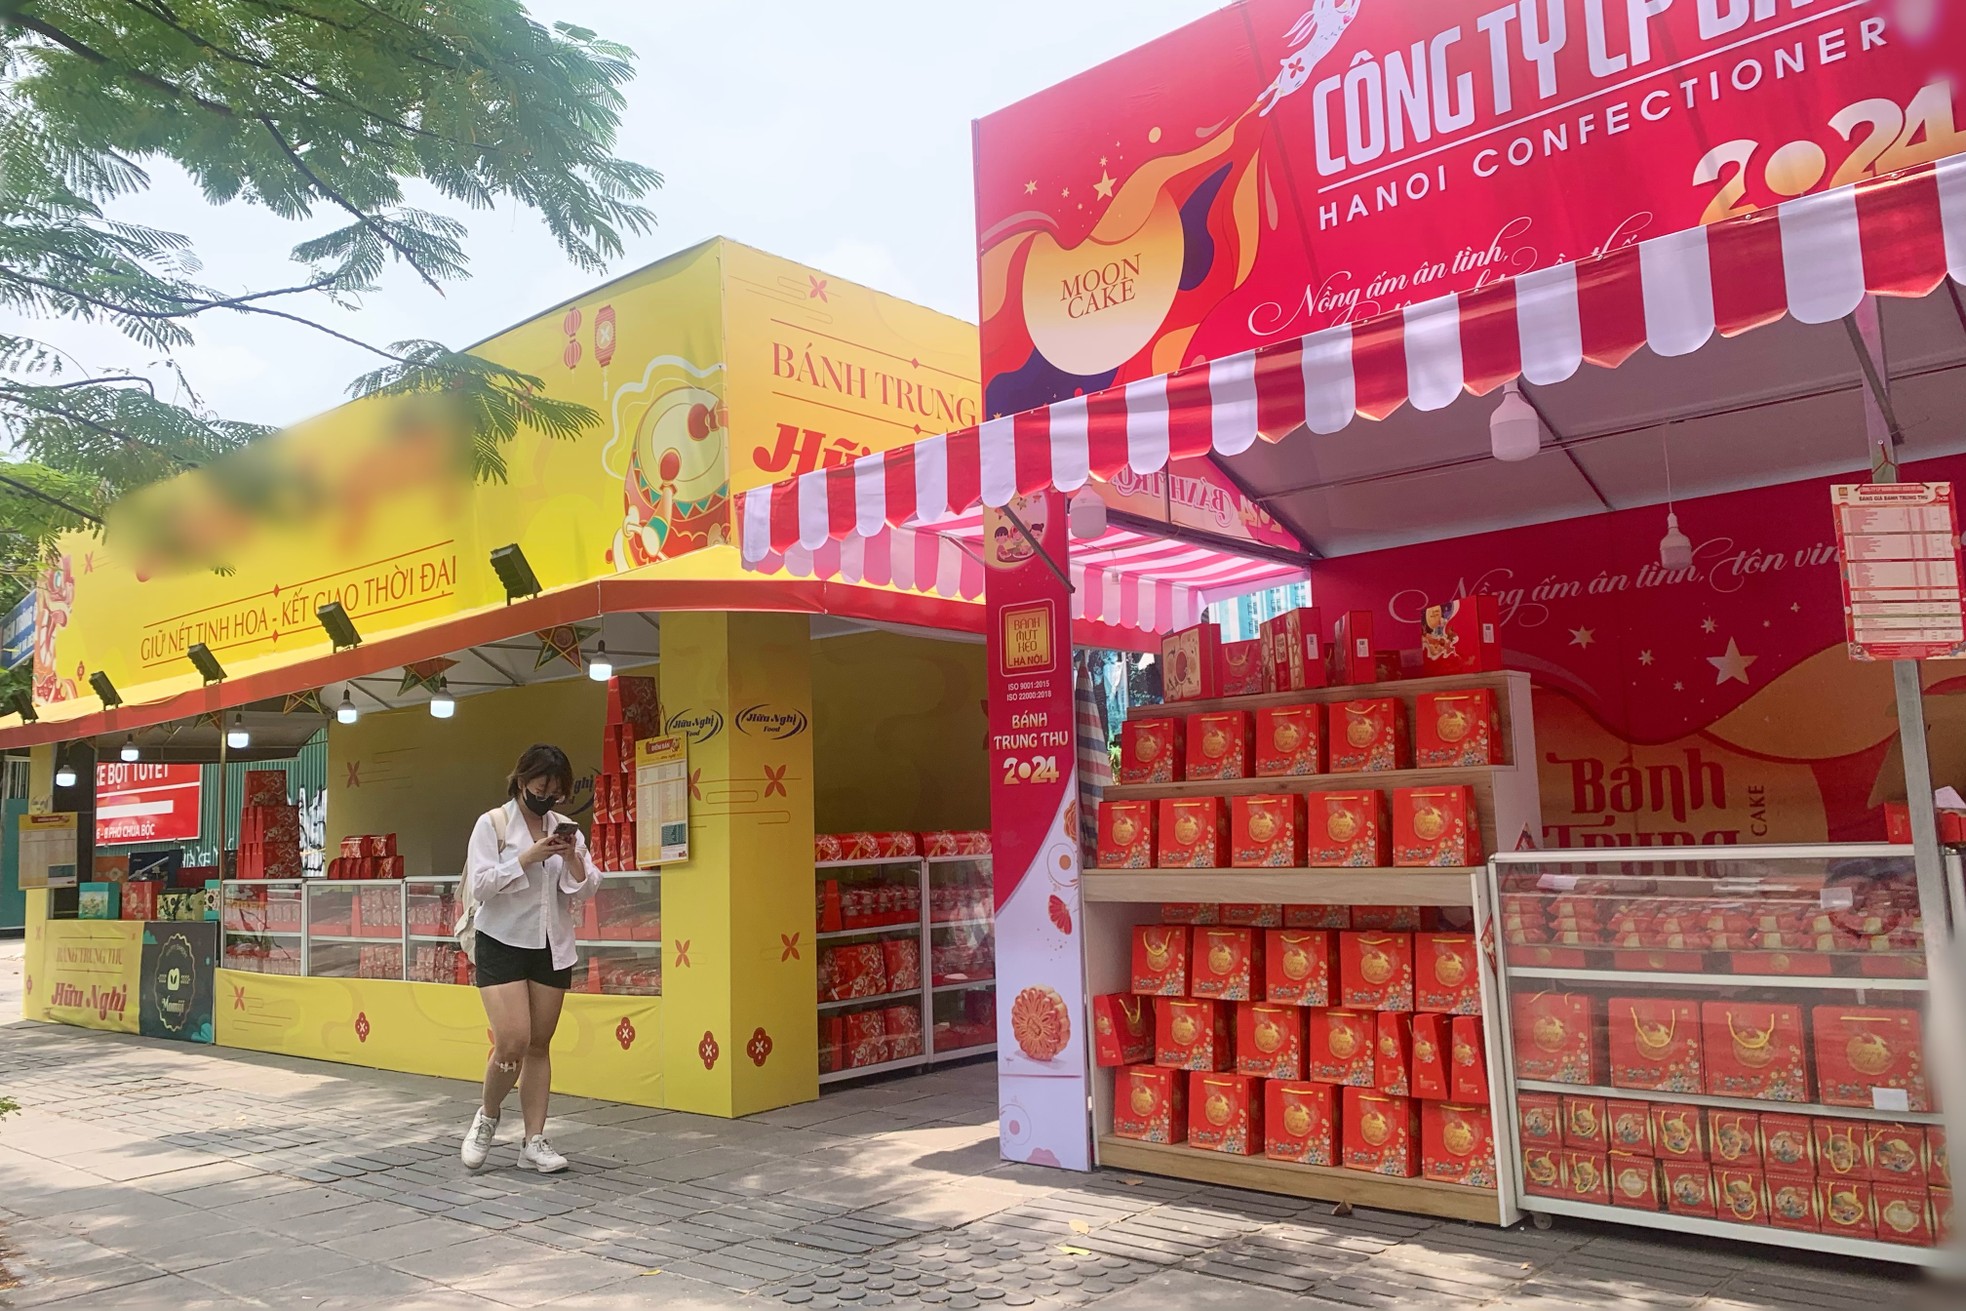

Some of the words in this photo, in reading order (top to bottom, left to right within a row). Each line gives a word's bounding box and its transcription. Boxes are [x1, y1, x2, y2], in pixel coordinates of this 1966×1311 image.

[1312, 25, 1476, 177] CÔNG
[1477, 0, 1567, 116] TY
[1318, 165, 1446, 231] HANOI
[1473, 16, 1888, 178] CONFECTIONER
[1692, 79, 1966, 227] 2024
[1060, 253, 1142, 302] MOON
[1365, 271, 1408, 299] ấm
[1413, 261, 1448, 286] ân
[1067, 279, 1137, 319] CAKE
[771, 342, 867, 400] BÁNH
[875, 371, 977, 427] TRUNG
[1532, 574, 1583, 602] ấm
[1588, 570, 1630, 594] ân
[1710, 548, 1788, 593] tôn
[141, 629, 166, 661] GIỮ
[168, 622, 192, 654] NÉT
[234, 607, 268, 639] HOA
[282, 587, 309, 627] KẾT
[364, 564, 414, 606] THỜI
[420, 555, 456, 595] ĐẠI
[1006, 693, 1018, 701] ISO
[1019, 690, 1052, 700] 22000:2018
[1007, 683, 1019, 691] ISO
[1020, 680, 1050, 690] 9001:2015
[746, 713, 769, 723] Hữu
[770, 713, 796, 726] Nghị
[763, 725, 781, 733] Food
[1012, 710, 1048, 729] BÁNH
[993, 733, 1037, 750] TRUNG
[1040, 730, 1068, 747] THU
[1003, 755, 1060, 785] 2024
[1546, 748, 1727, 823] Bánh
[1747, 785, 1768, 837] CAKE
[51, 982, 84, 1008] Hữu
[86, 984, 127, 1021] Nghị
